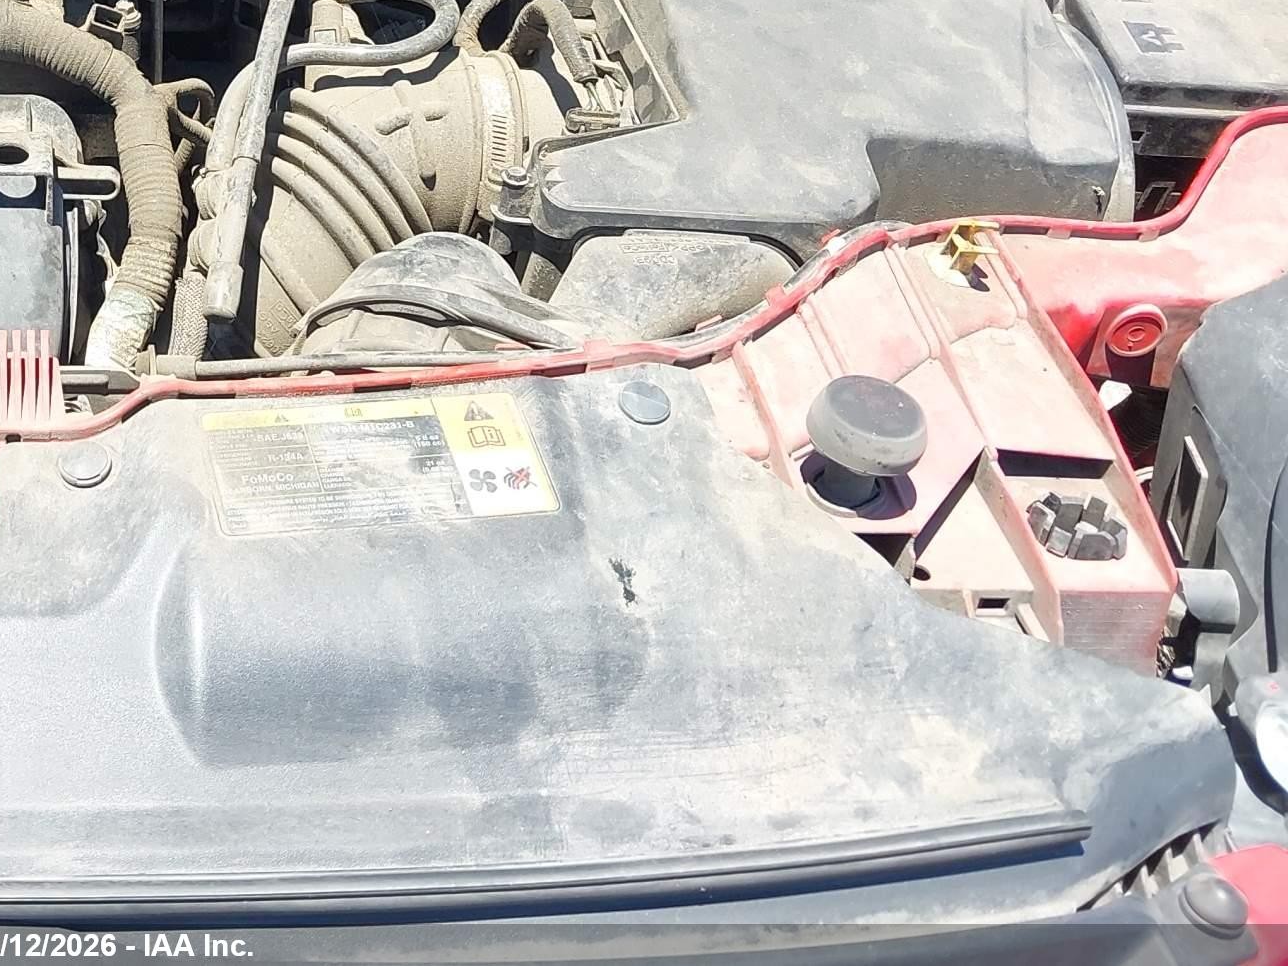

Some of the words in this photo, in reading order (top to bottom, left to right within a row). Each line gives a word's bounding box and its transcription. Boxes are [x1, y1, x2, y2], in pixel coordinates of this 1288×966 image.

[267, 451, 305, 463] R-134A
[241, 472, 294, 485] FoMoCo
[275, 481, 320, 491] MICHIGAN
